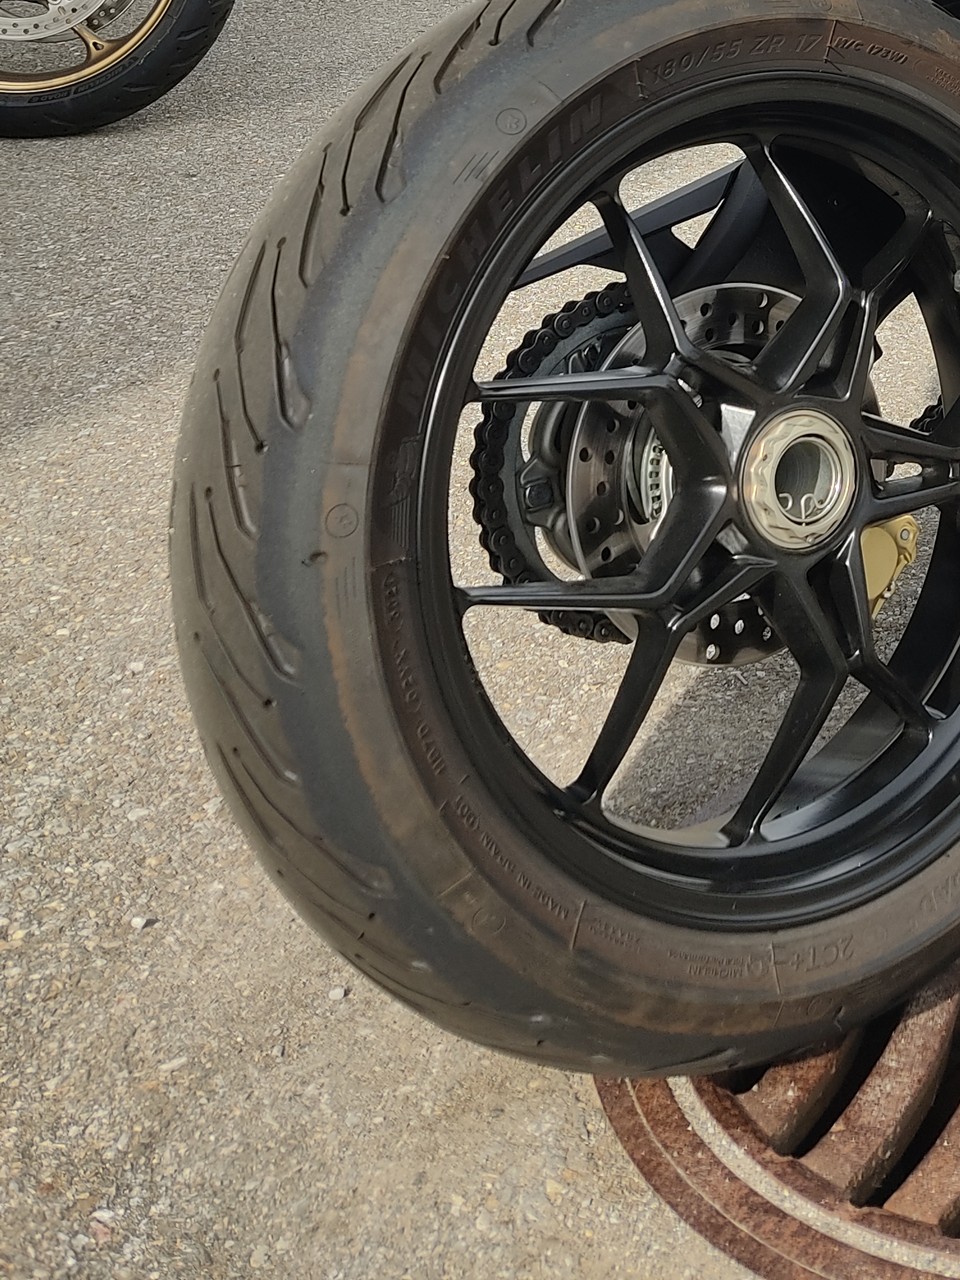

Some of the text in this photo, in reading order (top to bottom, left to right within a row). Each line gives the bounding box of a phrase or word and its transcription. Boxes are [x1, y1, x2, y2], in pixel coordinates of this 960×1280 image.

[650, 37, 744, 85] 180/55
[749, 34, 785, 56] ZR
[794, 33, 823, 54] 17
[514, 869, 533, 892] IN
